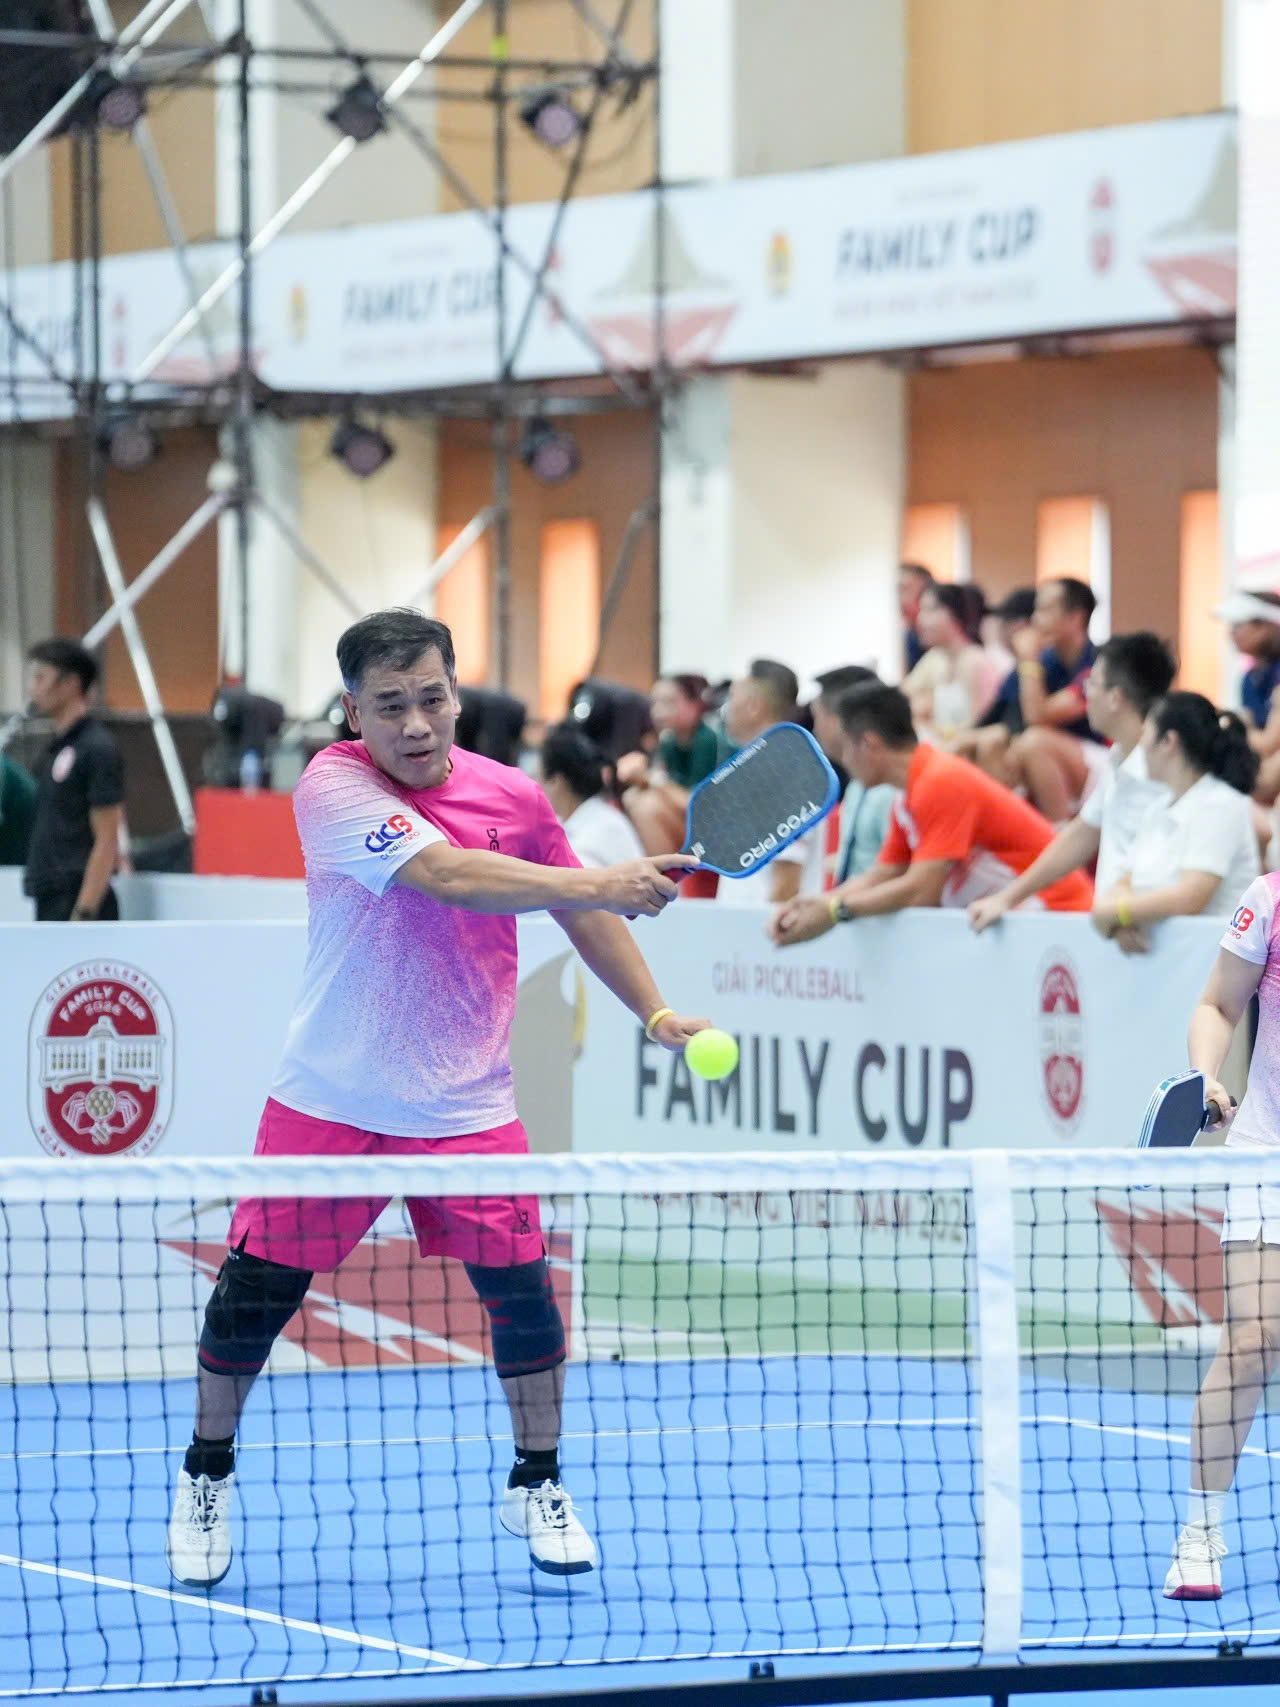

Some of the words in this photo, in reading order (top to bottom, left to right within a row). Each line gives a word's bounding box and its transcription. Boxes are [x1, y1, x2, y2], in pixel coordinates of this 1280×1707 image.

[968, 203, 1040, 264] CUP
[739, 832, 779, 868] PRO
[59, 985, 113, 1022] FAMILY
[118, 990, 147, 1020] CUP
[754, 963, 865, 1004] PICKLEBALL
[634, 1024, 832, 1138] FAMILY
[853, 1040, 975, 1150] CUP
[919, 1192, 963, 1243] 202
